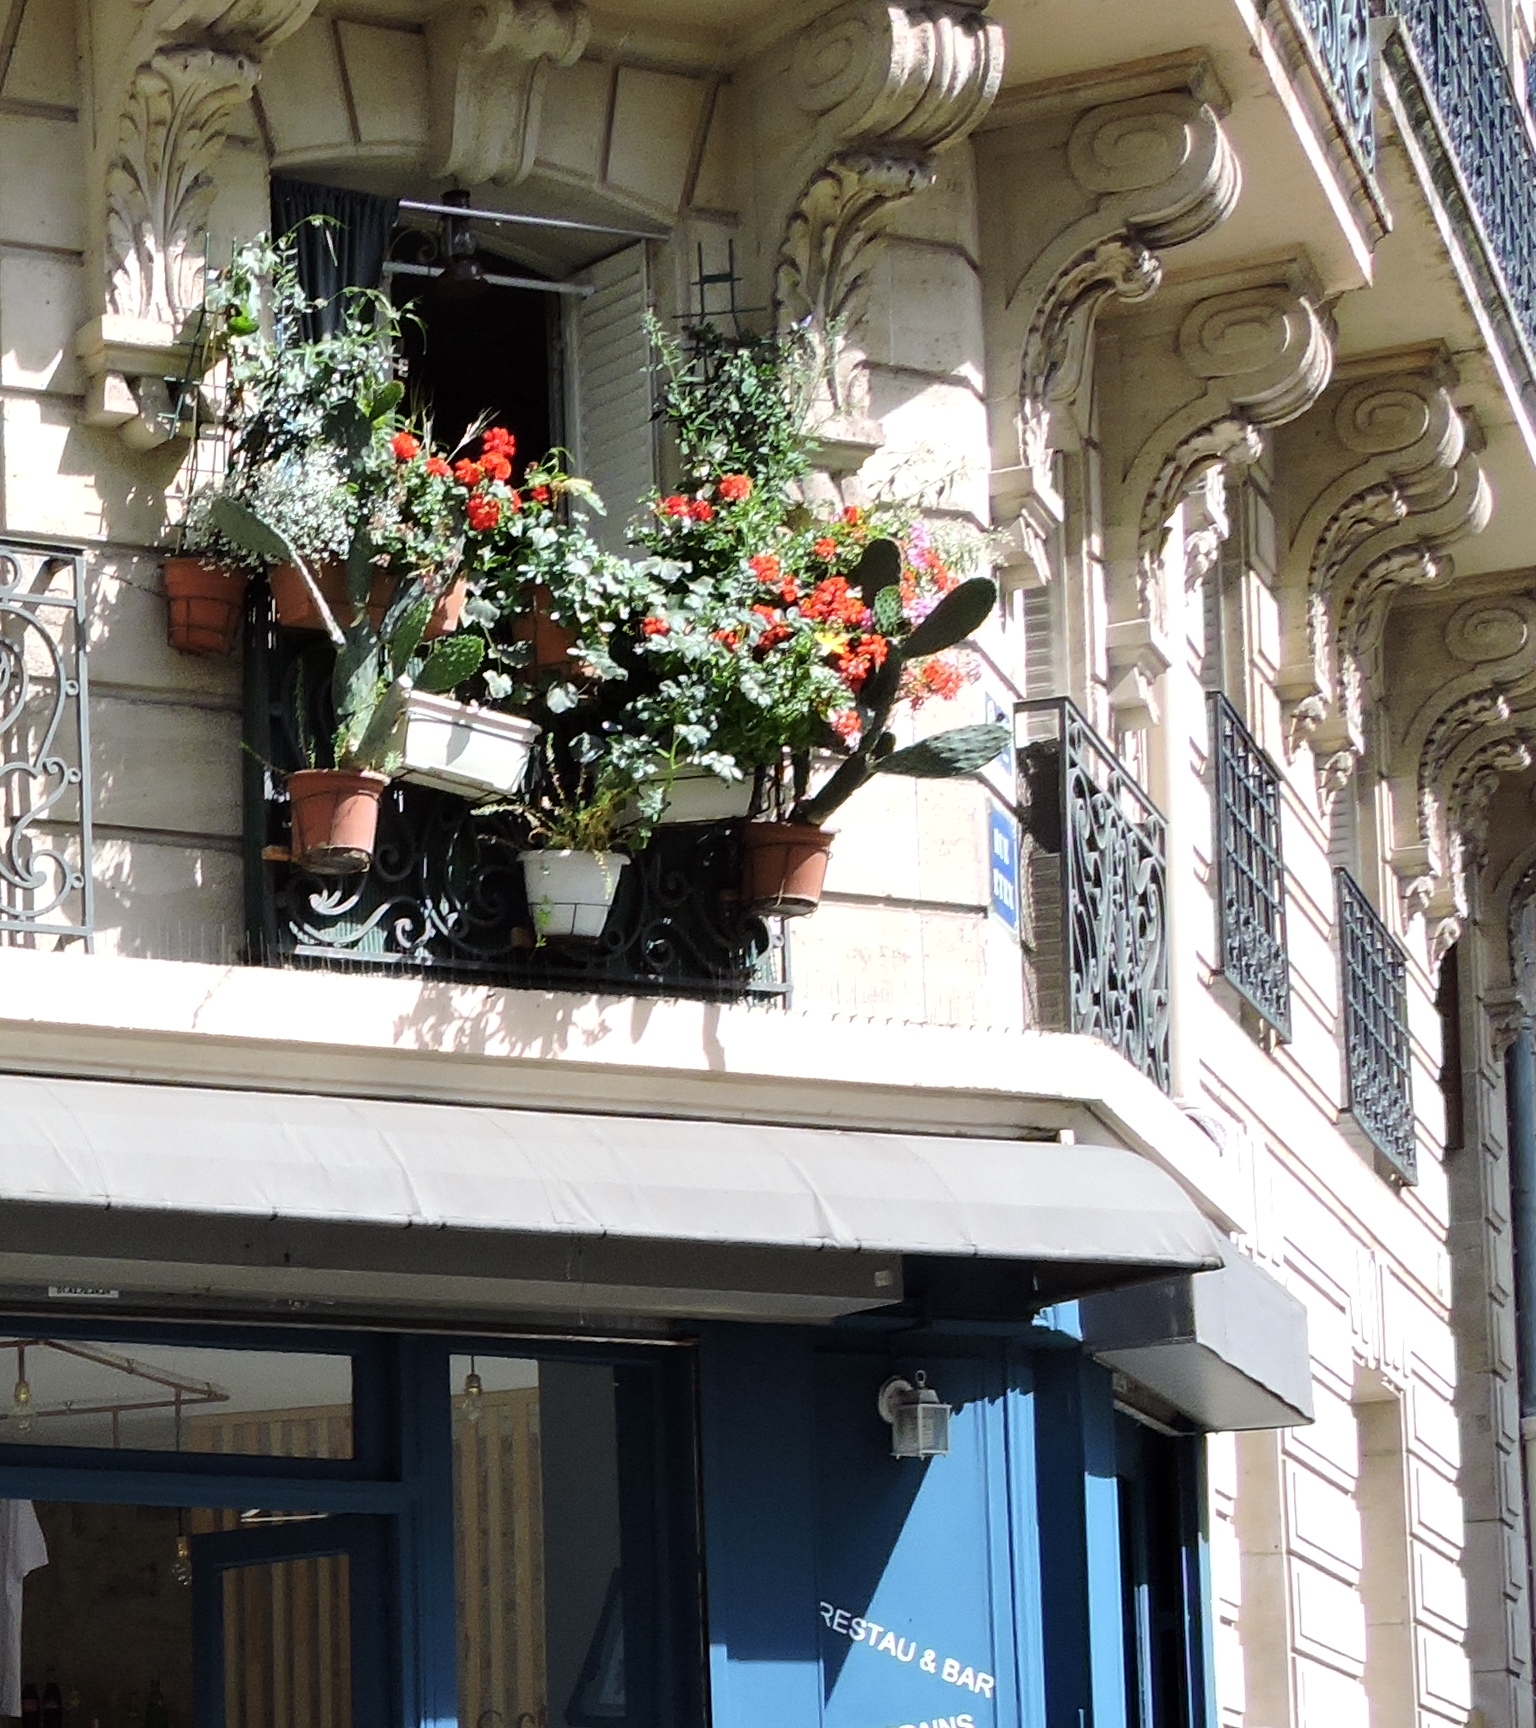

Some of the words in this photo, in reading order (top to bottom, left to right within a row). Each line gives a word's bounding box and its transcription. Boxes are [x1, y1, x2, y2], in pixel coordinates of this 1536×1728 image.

[820, 1601, 916, 1662] RESTAU
[920, 1649, 936, 1673] &
[941, 1658, 995, 1698] BAR
